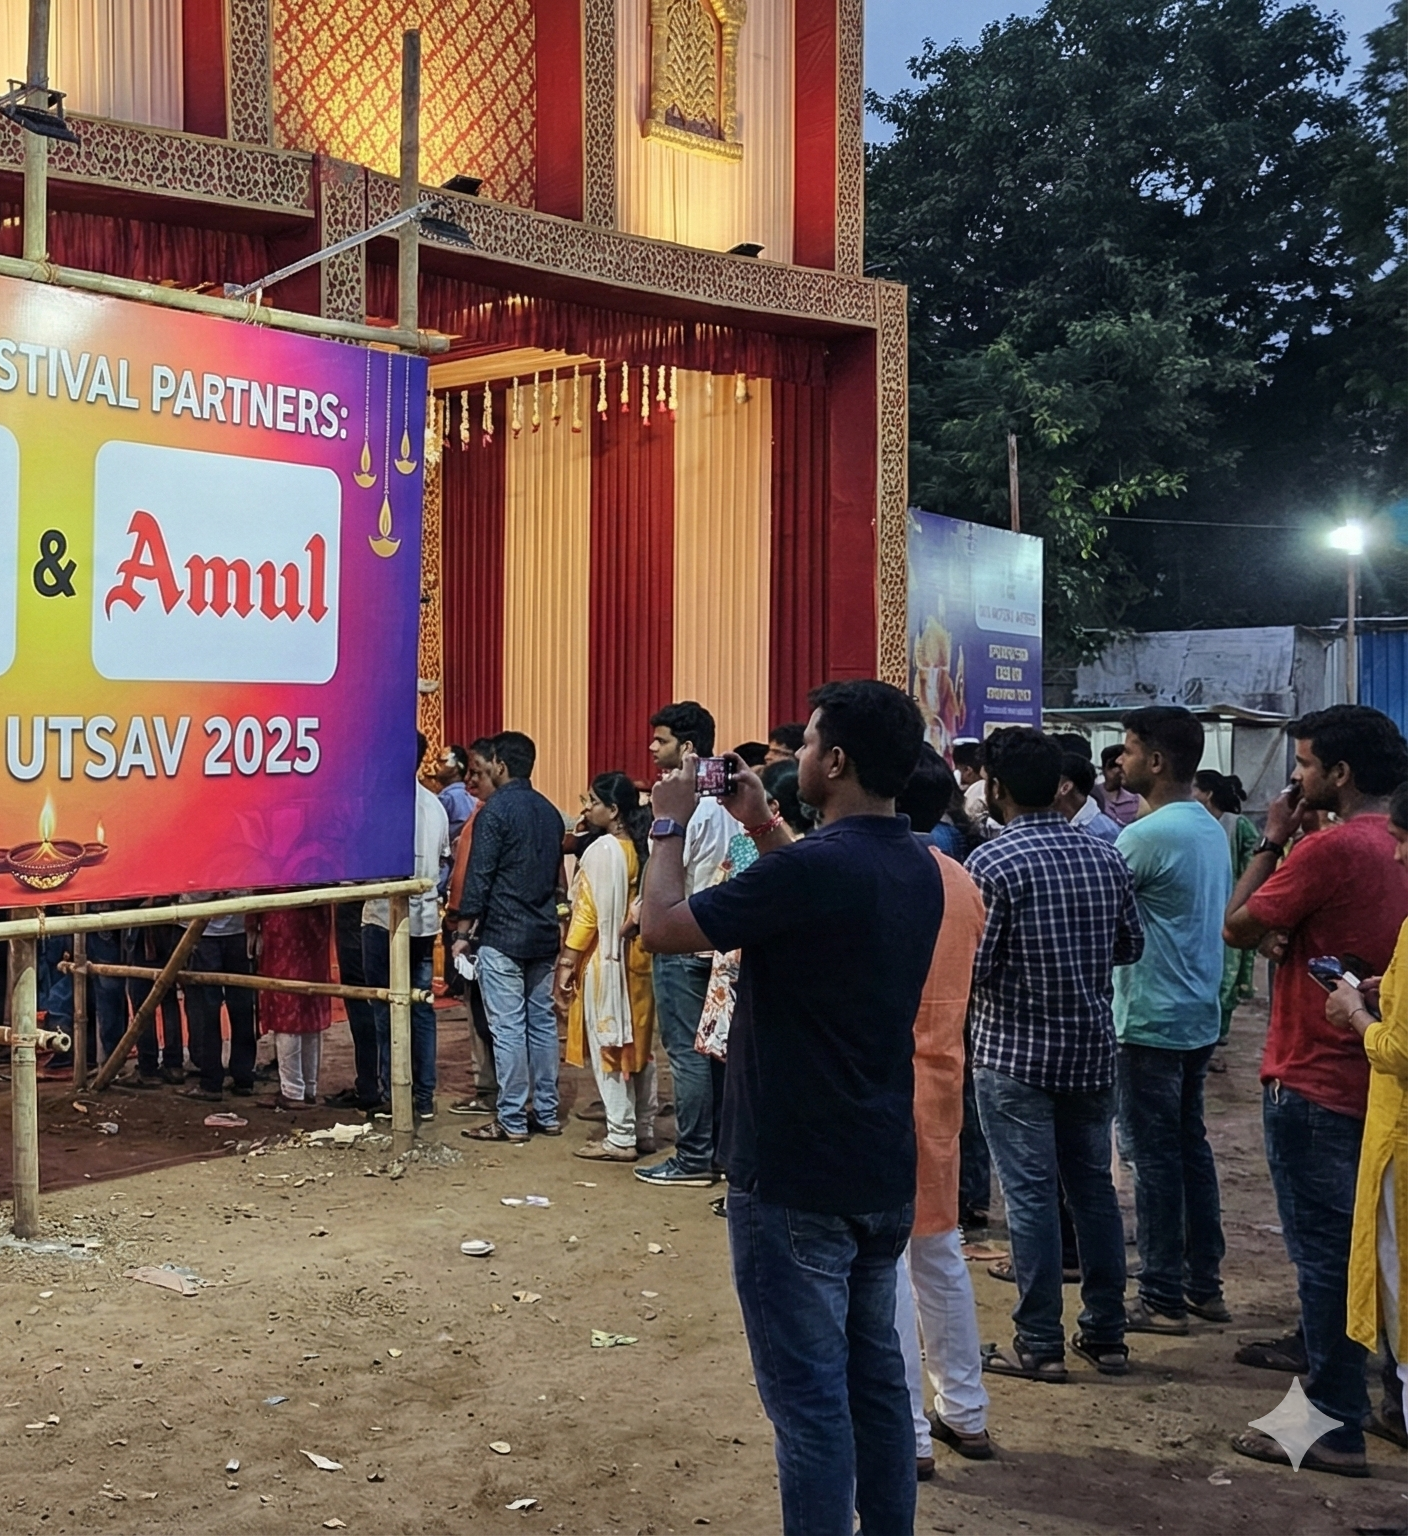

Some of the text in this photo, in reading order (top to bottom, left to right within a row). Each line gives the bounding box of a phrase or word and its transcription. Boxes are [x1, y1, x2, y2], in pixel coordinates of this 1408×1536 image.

[151, 365, 350, 439] PARTNERS:
[33, 528, 78, 599] &
[105, 511, 328, 623] Amul
[7, 715, 191, 780] UTSAV
[204, 716, 320, 775] 2025
